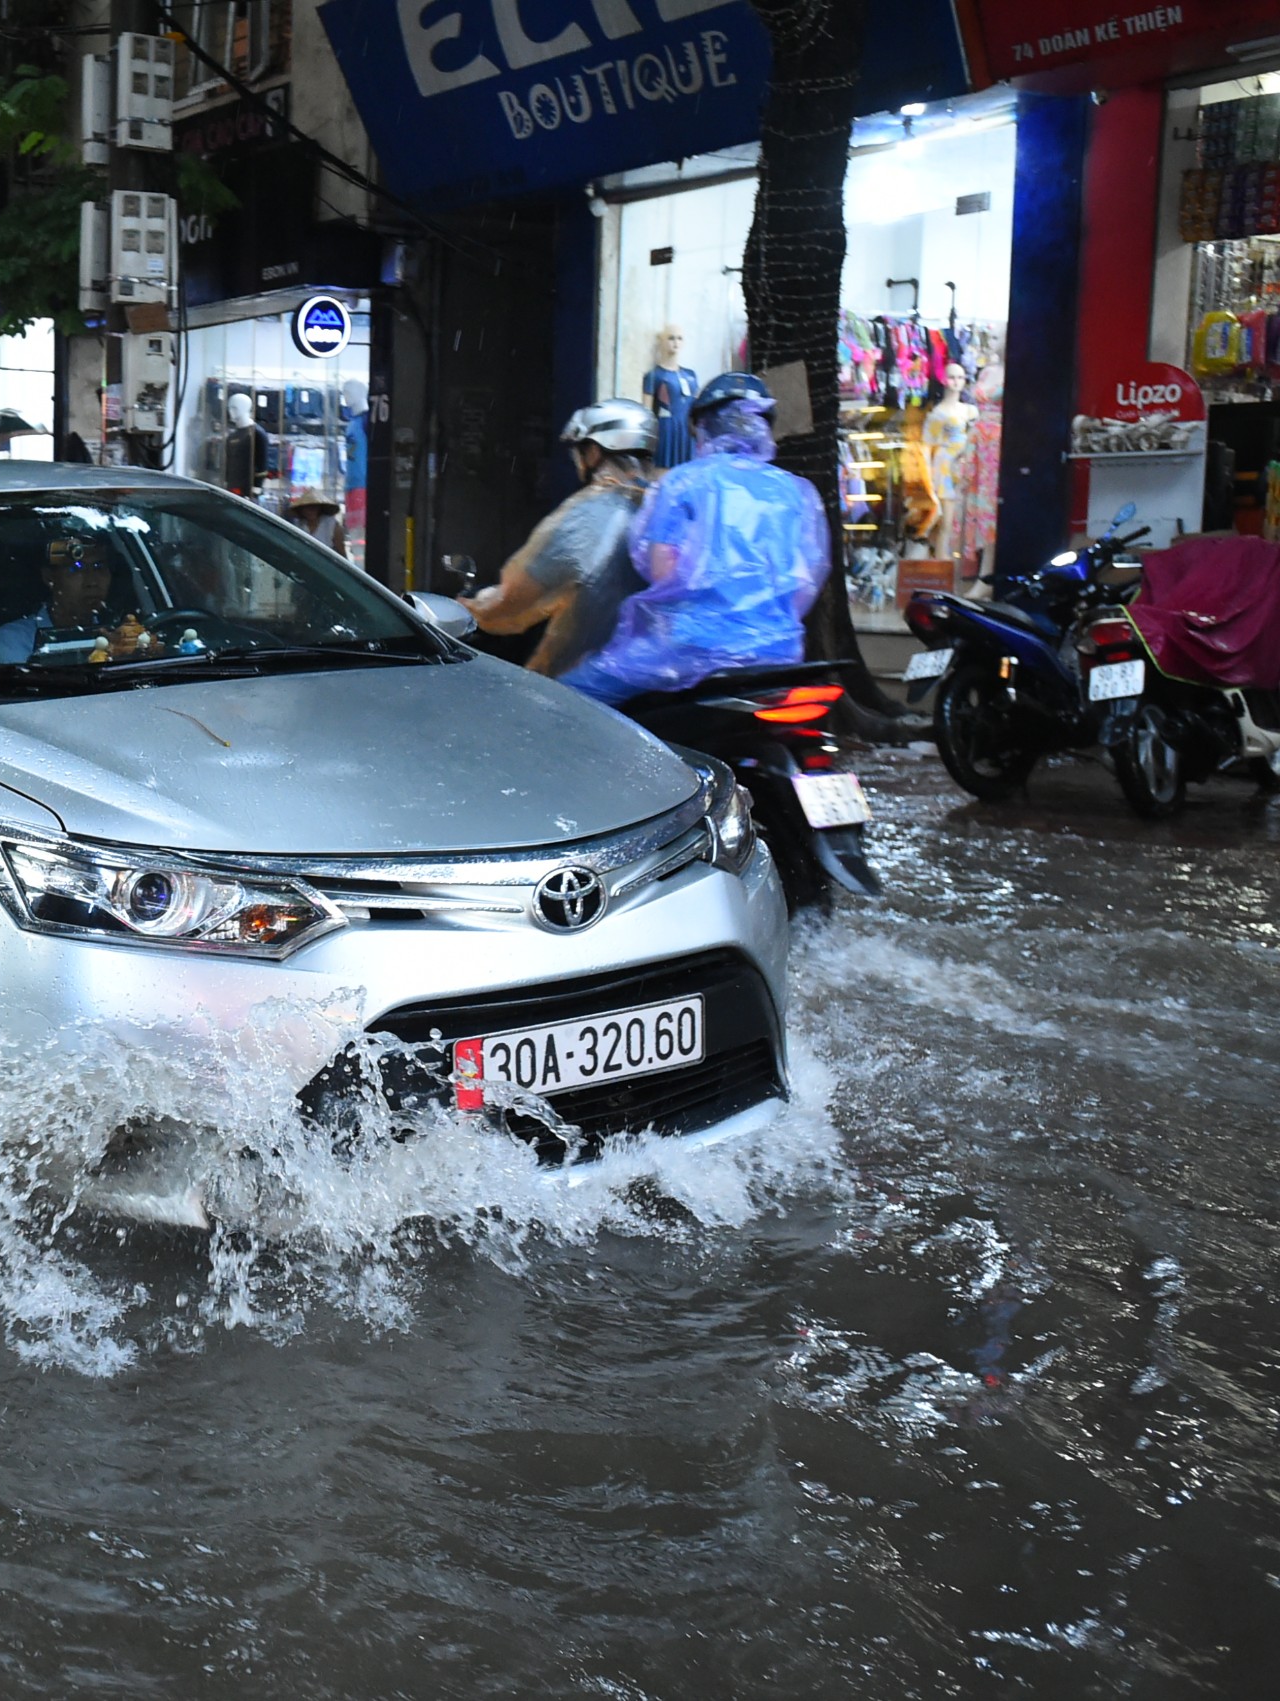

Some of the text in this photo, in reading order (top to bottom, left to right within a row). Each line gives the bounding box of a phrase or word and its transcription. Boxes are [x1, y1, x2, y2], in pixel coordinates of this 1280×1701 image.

[1011, 43, 1035, 61] 74
[1123, 5, 1184, 36] THIỆN
[498, 30, 737, 140] BOUTIQUE
[370, 394, 389, 423] 76
[1116, 381, 1182, 410] Lipzo
[489, 1006, 697, 1090] 30A-320.60
